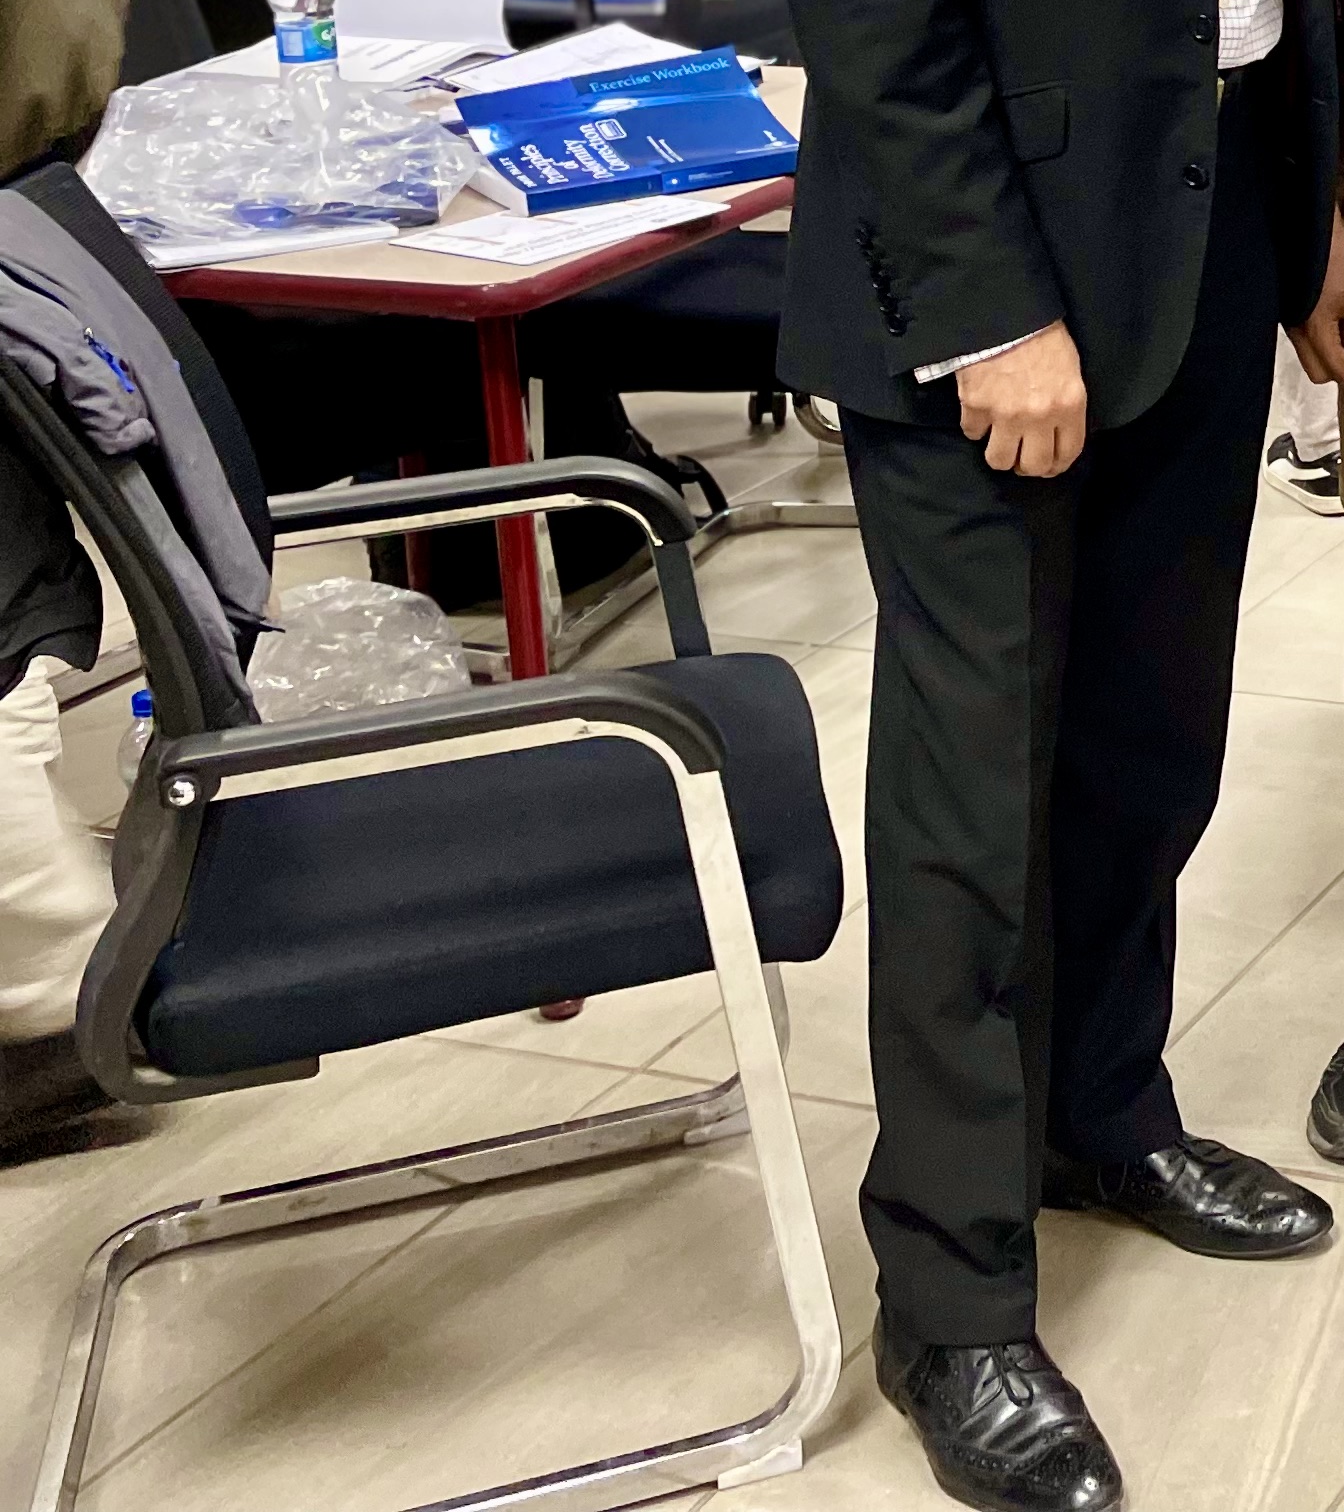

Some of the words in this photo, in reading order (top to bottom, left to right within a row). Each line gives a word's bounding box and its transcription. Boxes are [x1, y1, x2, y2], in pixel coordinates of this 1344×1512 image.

[589, 73, 652, 94] Exercise
[652, 56, 732, 82] Workbook
[520, 143, 569, 185] Principles
[552, 157, 579, 170] of
[563, 139, 615, 181] Deformity
[579, 123, 631, 172] Correction
